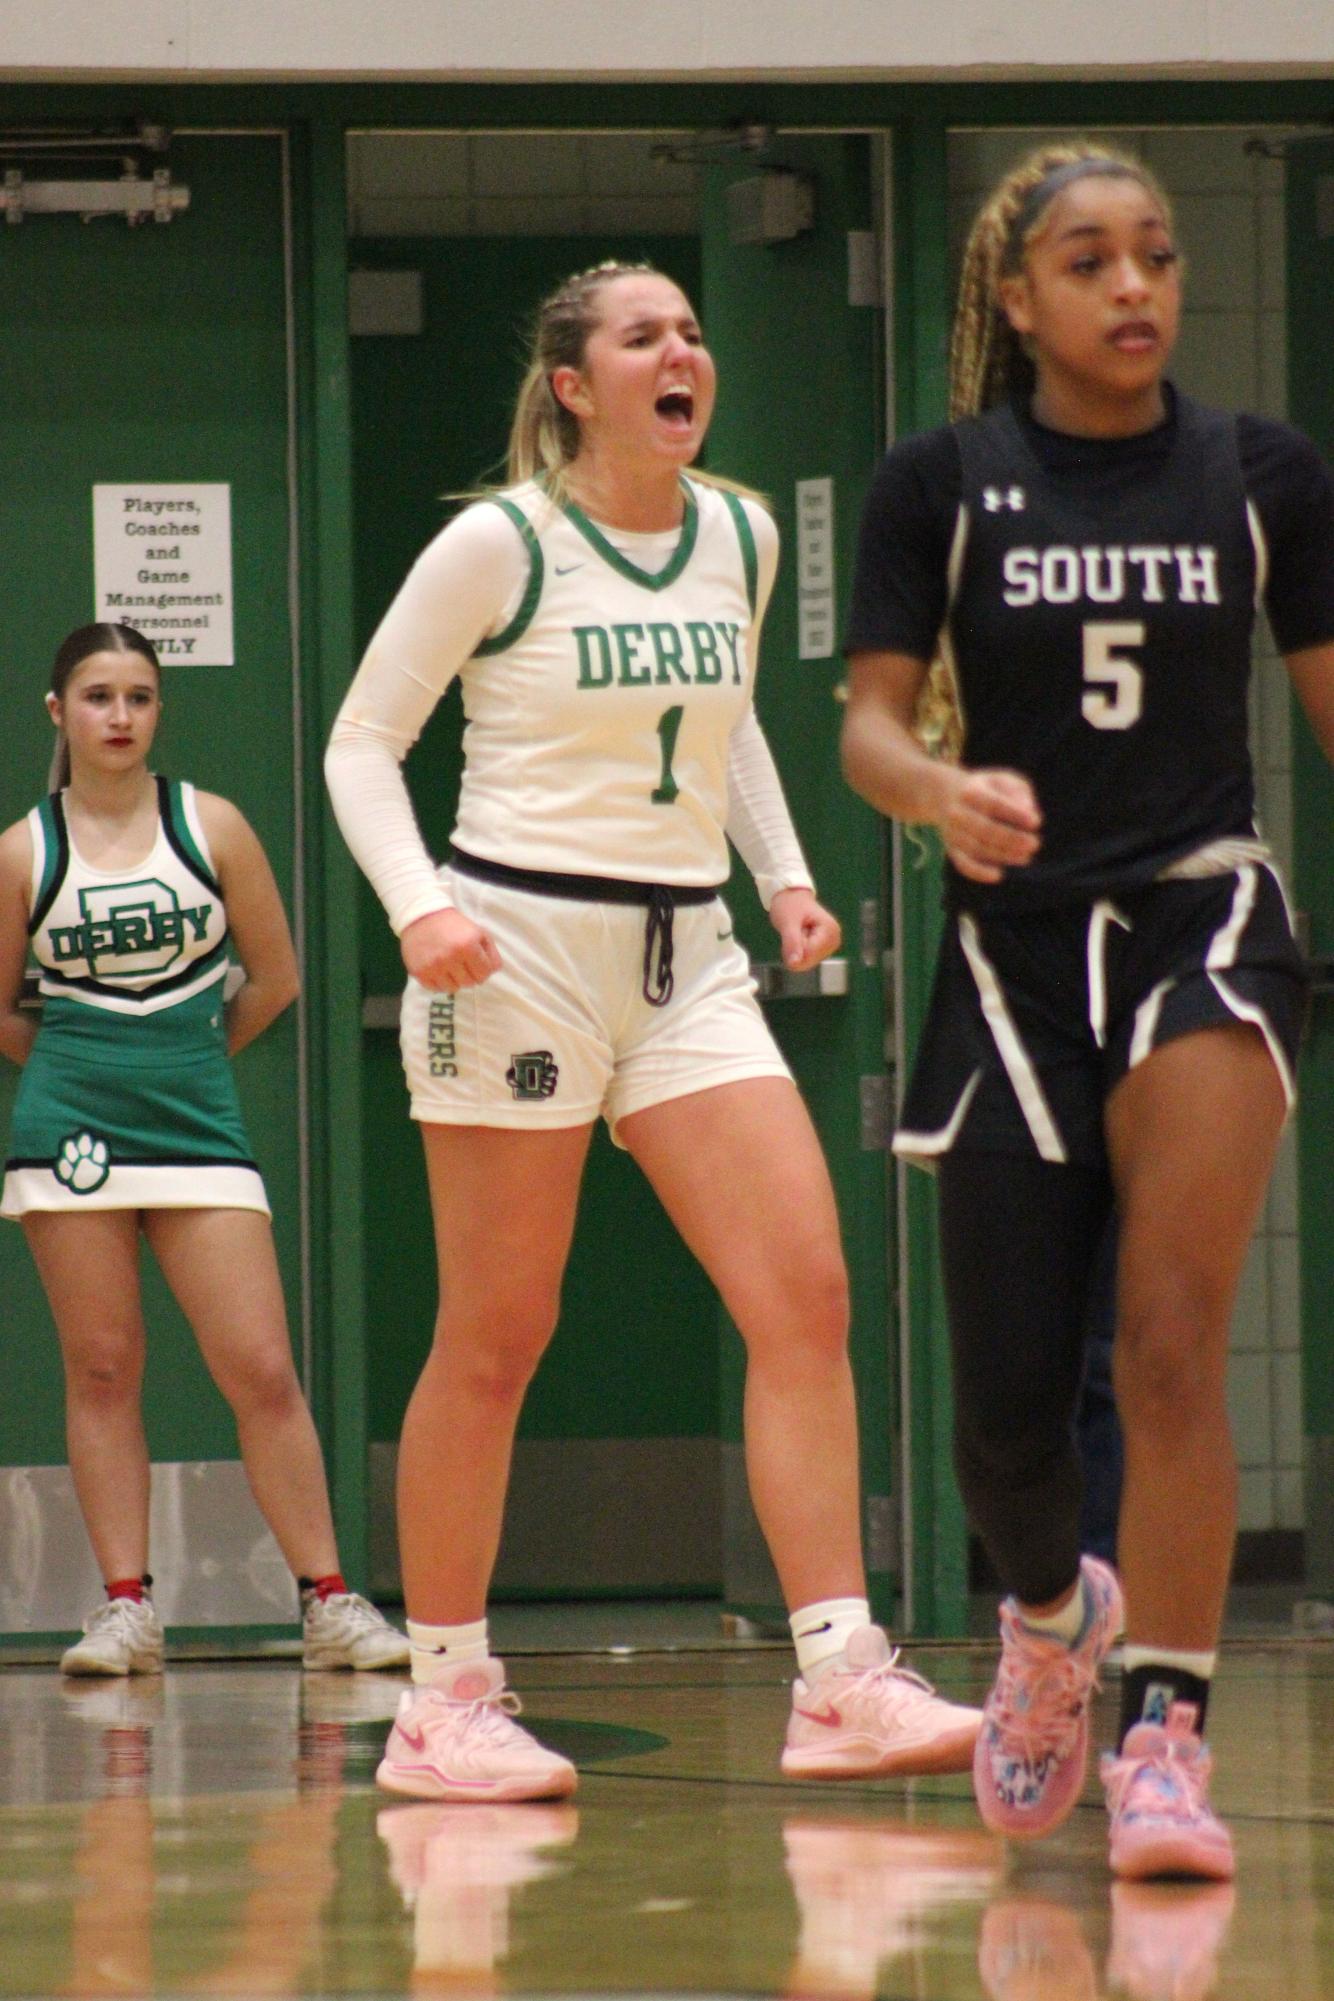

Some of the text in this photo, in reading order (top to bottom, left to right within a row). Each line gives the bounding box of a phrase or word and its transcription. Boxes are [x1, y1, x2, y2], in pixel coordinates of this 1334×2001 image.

[123, 498, 200, 515] Players,
[124, 522, 201, 536] Coaches
[145, 546, 181, 560] and
[137, 569, 190, 583] Game
[1003, 545, 1221, 607] SOUTH
[105, 594, 224, 609] Management
[120, 616, 209, 629] Personnel
[150, 638, 196, 654] NLY
[572, 621, 742, 689] DERBY
[1081, 620, 1146, 731] 5
[650, 705, 684, 805] 1
[48, 904, 212, 962] DERBY
[428, 992, 458, 1077] HERS
